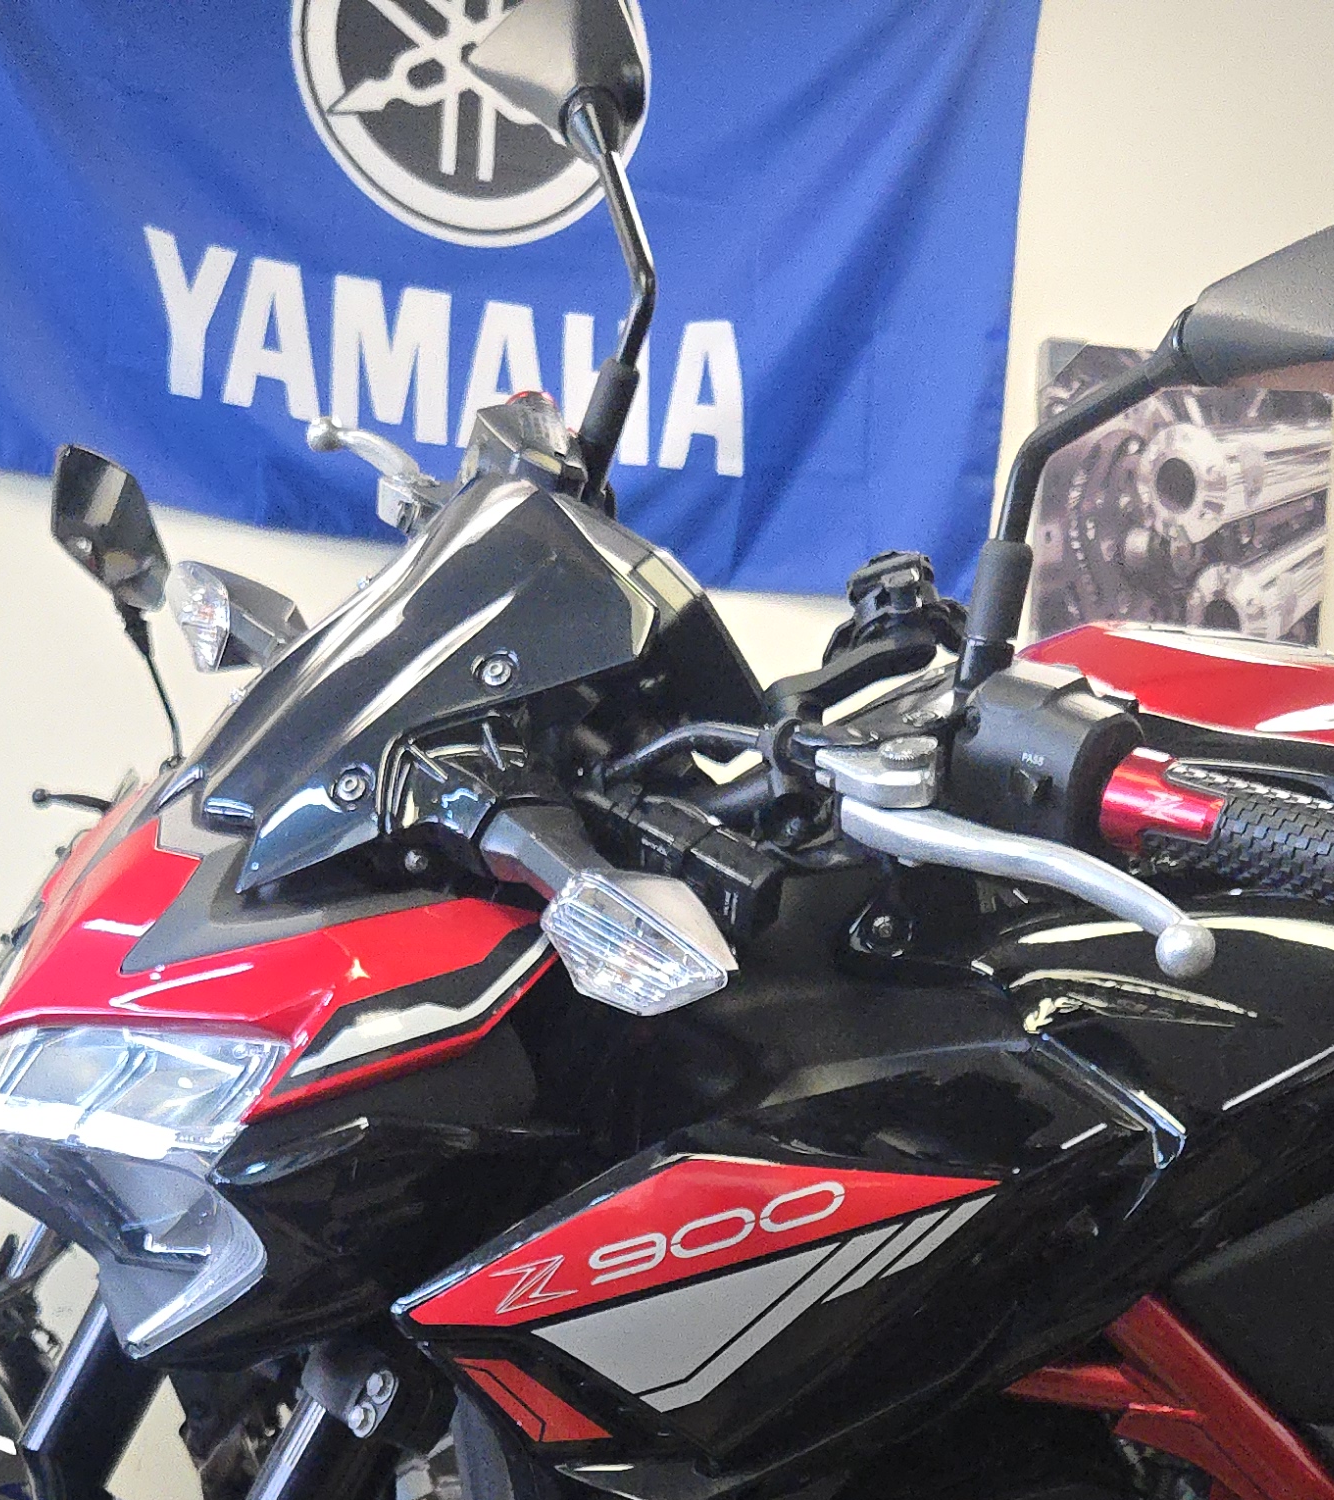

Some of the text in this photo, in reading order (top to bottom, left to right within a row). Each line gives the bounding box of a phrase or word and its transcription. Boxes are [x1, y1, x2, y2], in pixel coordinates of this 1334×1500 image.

[143, 225, 746, 478] YAMAHA
[1020, 751, 1045, 767] PASS
[587, 1180, 846, 1287] 900
